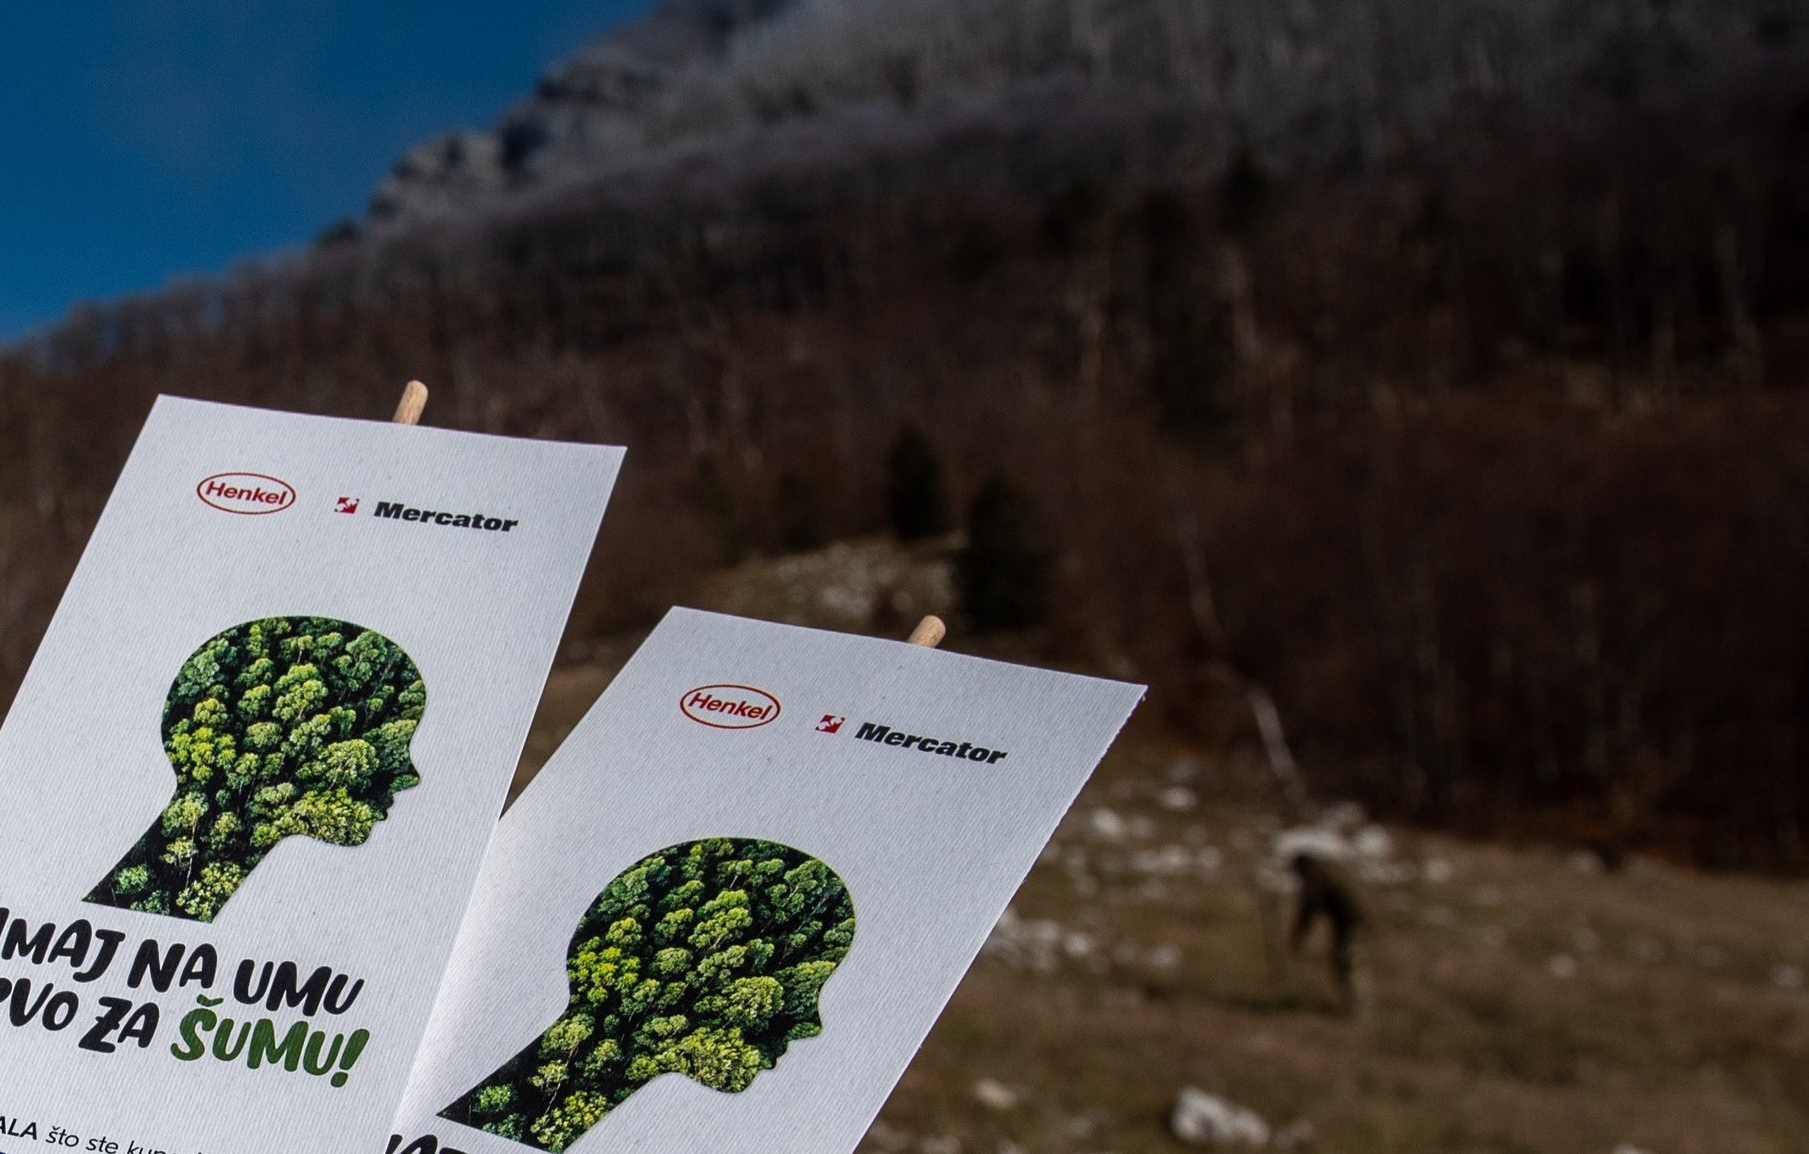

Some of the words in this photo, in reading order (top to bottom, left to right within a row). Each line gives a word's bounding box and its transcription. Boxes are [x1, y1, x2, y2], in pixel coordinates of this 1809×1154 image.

[205, 481, 287, 505] Henkel
[374, 501, 519, 532] Mercator
[688, 692, 773, 720] Henkel
[855, 722, 1007, 764] Mercator
[127, 939, 217, 993] NA
[233, 959, 365, 1017] UMU
[78, 996, 160, 1053] ZA
[170, 994, 370, 1088] ŠUMU!
[46, 1125, 80, 1149] što
